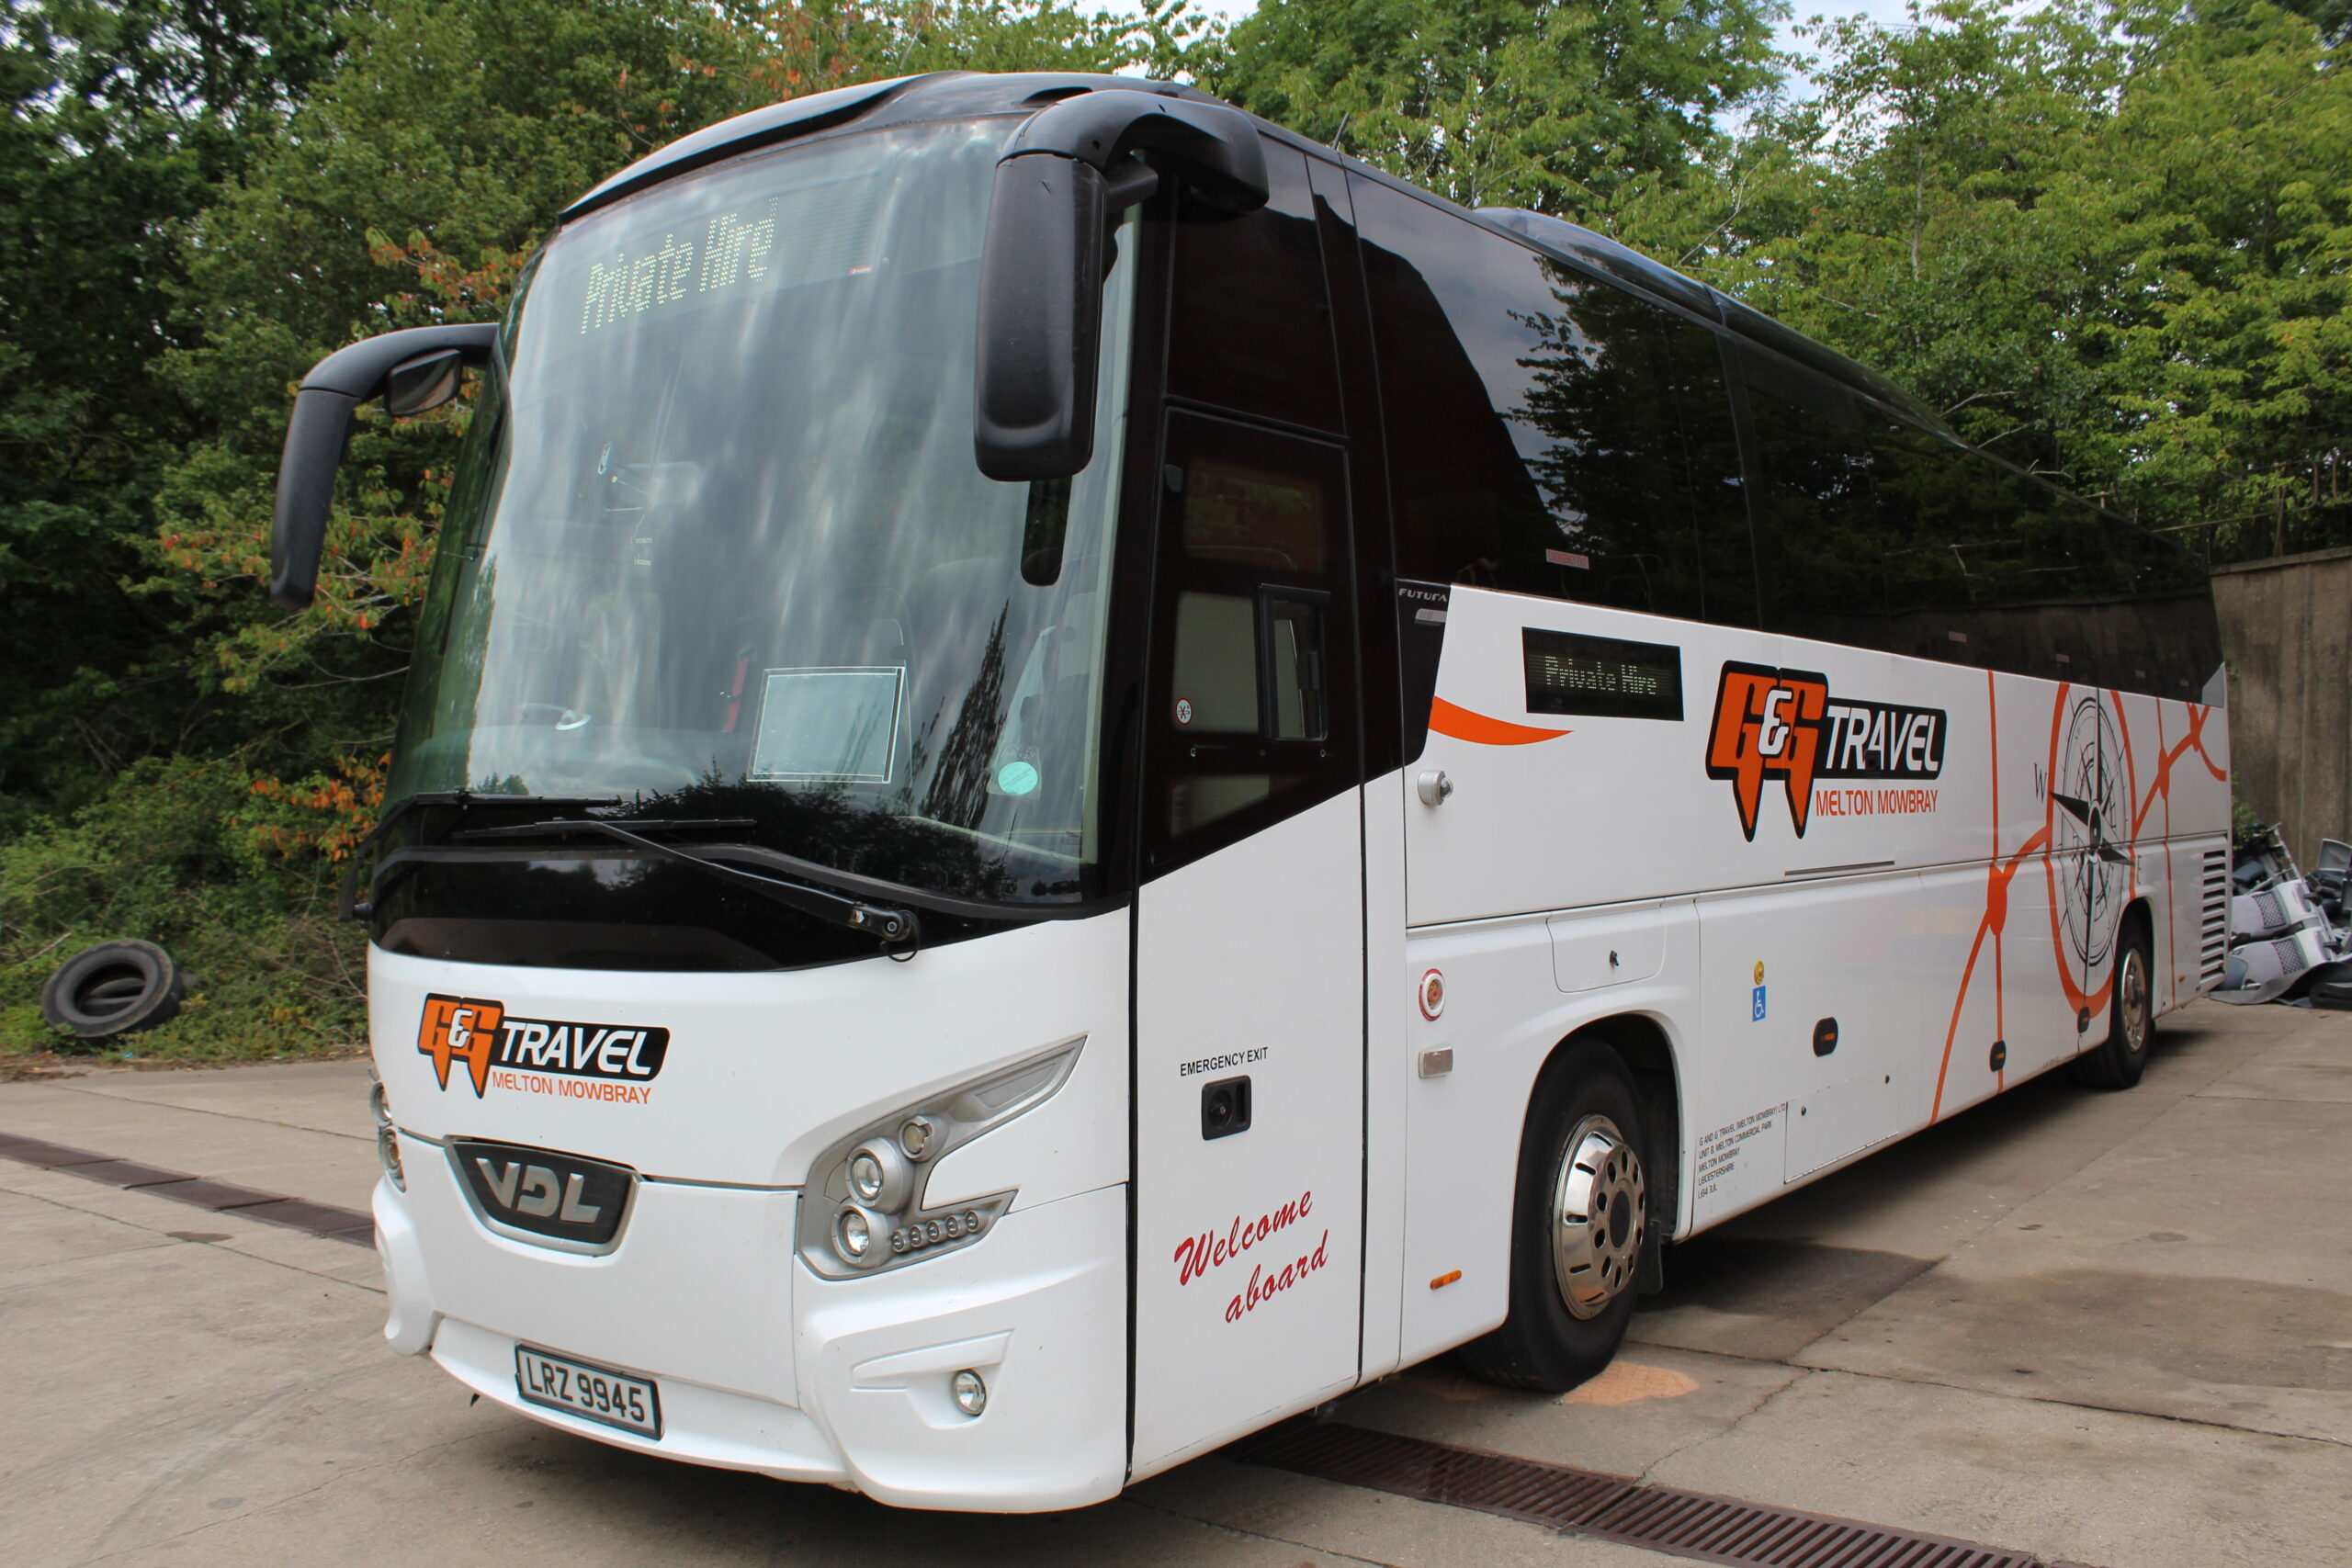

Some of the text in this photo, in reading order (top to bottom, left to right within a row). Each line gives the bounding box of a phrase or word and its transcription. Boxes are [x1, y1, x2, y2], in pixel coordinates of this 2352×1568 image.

[581, 212, 775, 335] Private Hire
[1544, 655, 1657, 694] Private Hire
[1826, 705, 1939, 772] TRAVEL
[1815, 789, 1939, 817] MELTON MOWBRAY
[501, 1021, 653, 1076] TRAVEL
[1180, 1046, 1269, 1077] EMERGENCY EXIT
[492, 1071, 652, 1105] MELTON MOWBRAY
[1719, 1123, 1736, 1137] TRAVEL
[476, 1157, 601, 1224] VDL
[1174, 1190, 1313, 1286] Welcome
[1225, 1228, 1329, 1323] aboard
[526, 1356, 645, 1423] LRZ 9945
